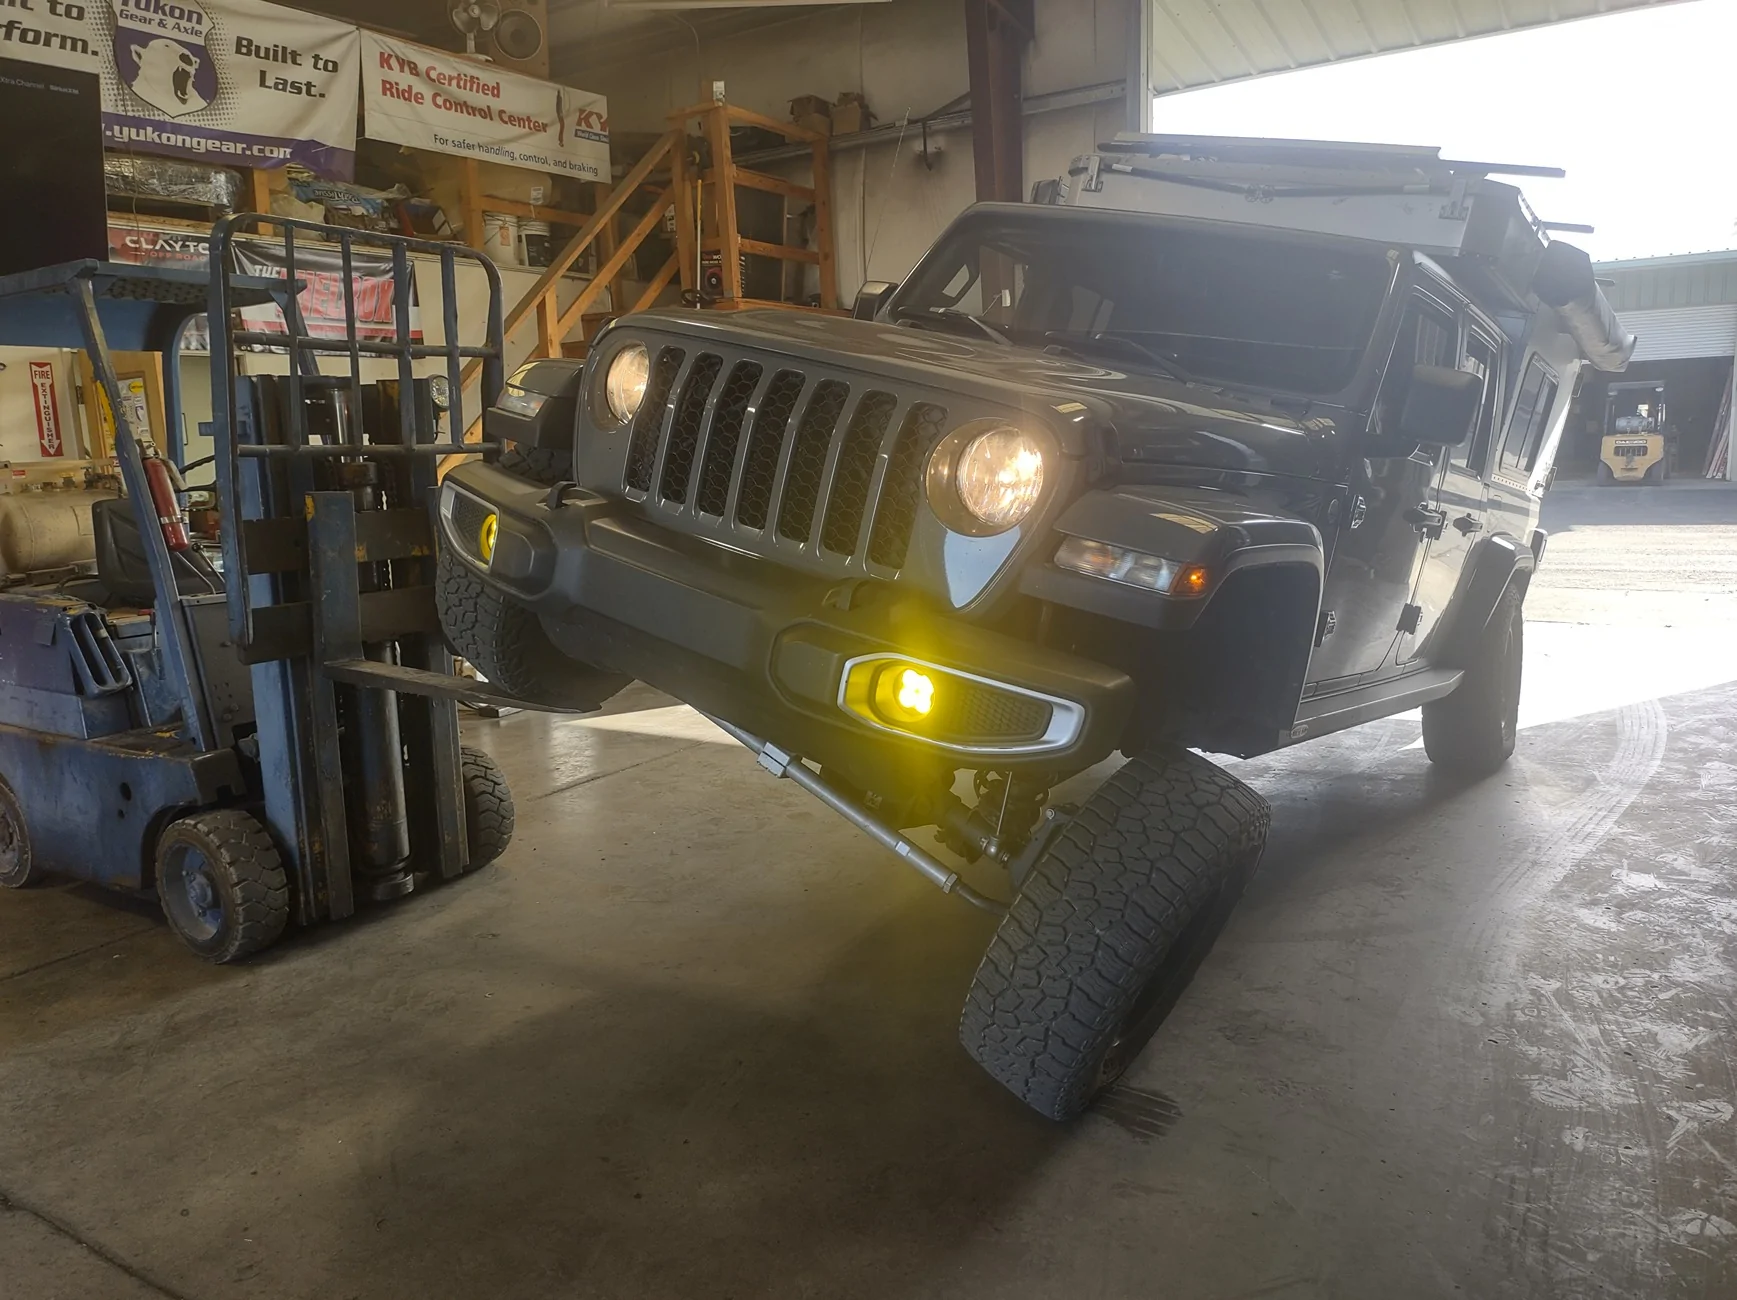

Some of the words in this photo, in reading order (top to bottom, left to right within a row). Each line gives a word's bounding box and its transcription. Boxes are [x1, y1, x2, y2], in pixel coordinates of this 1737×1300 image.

[120, 0, 203, 25] ukon
[120, 9, 155, 25] Gear
[157, 18, 168, 29] &
[171, 20, 203, 38] Axle
[0, 20, 99, 57] form.
[235, 35, 302, 67] Built
[312, 53, 339, 73] to
[259, 69, 326, 98] Last.
[379, 51, 420, 77] KYB
[425, 66, 500, 98] Certified
[381, 79, 424, 106] Ride
[431, 92, 493, 121] Control
[498, 109, 548, 133] Center
[433, 133, 449, 146] For
[451, 138, 475, 151] safer
[478, 142, 517, 161] handling,
[519, 153, 551, 166] control,
[552, 159, 567, 169] and
[569, 161, 598, 177] braking
[125, 236, 210, 254] CLAYTO
[33, 370, 51, 380] FIRE
[41, 382, 55, 450] EXTINGUISHER
